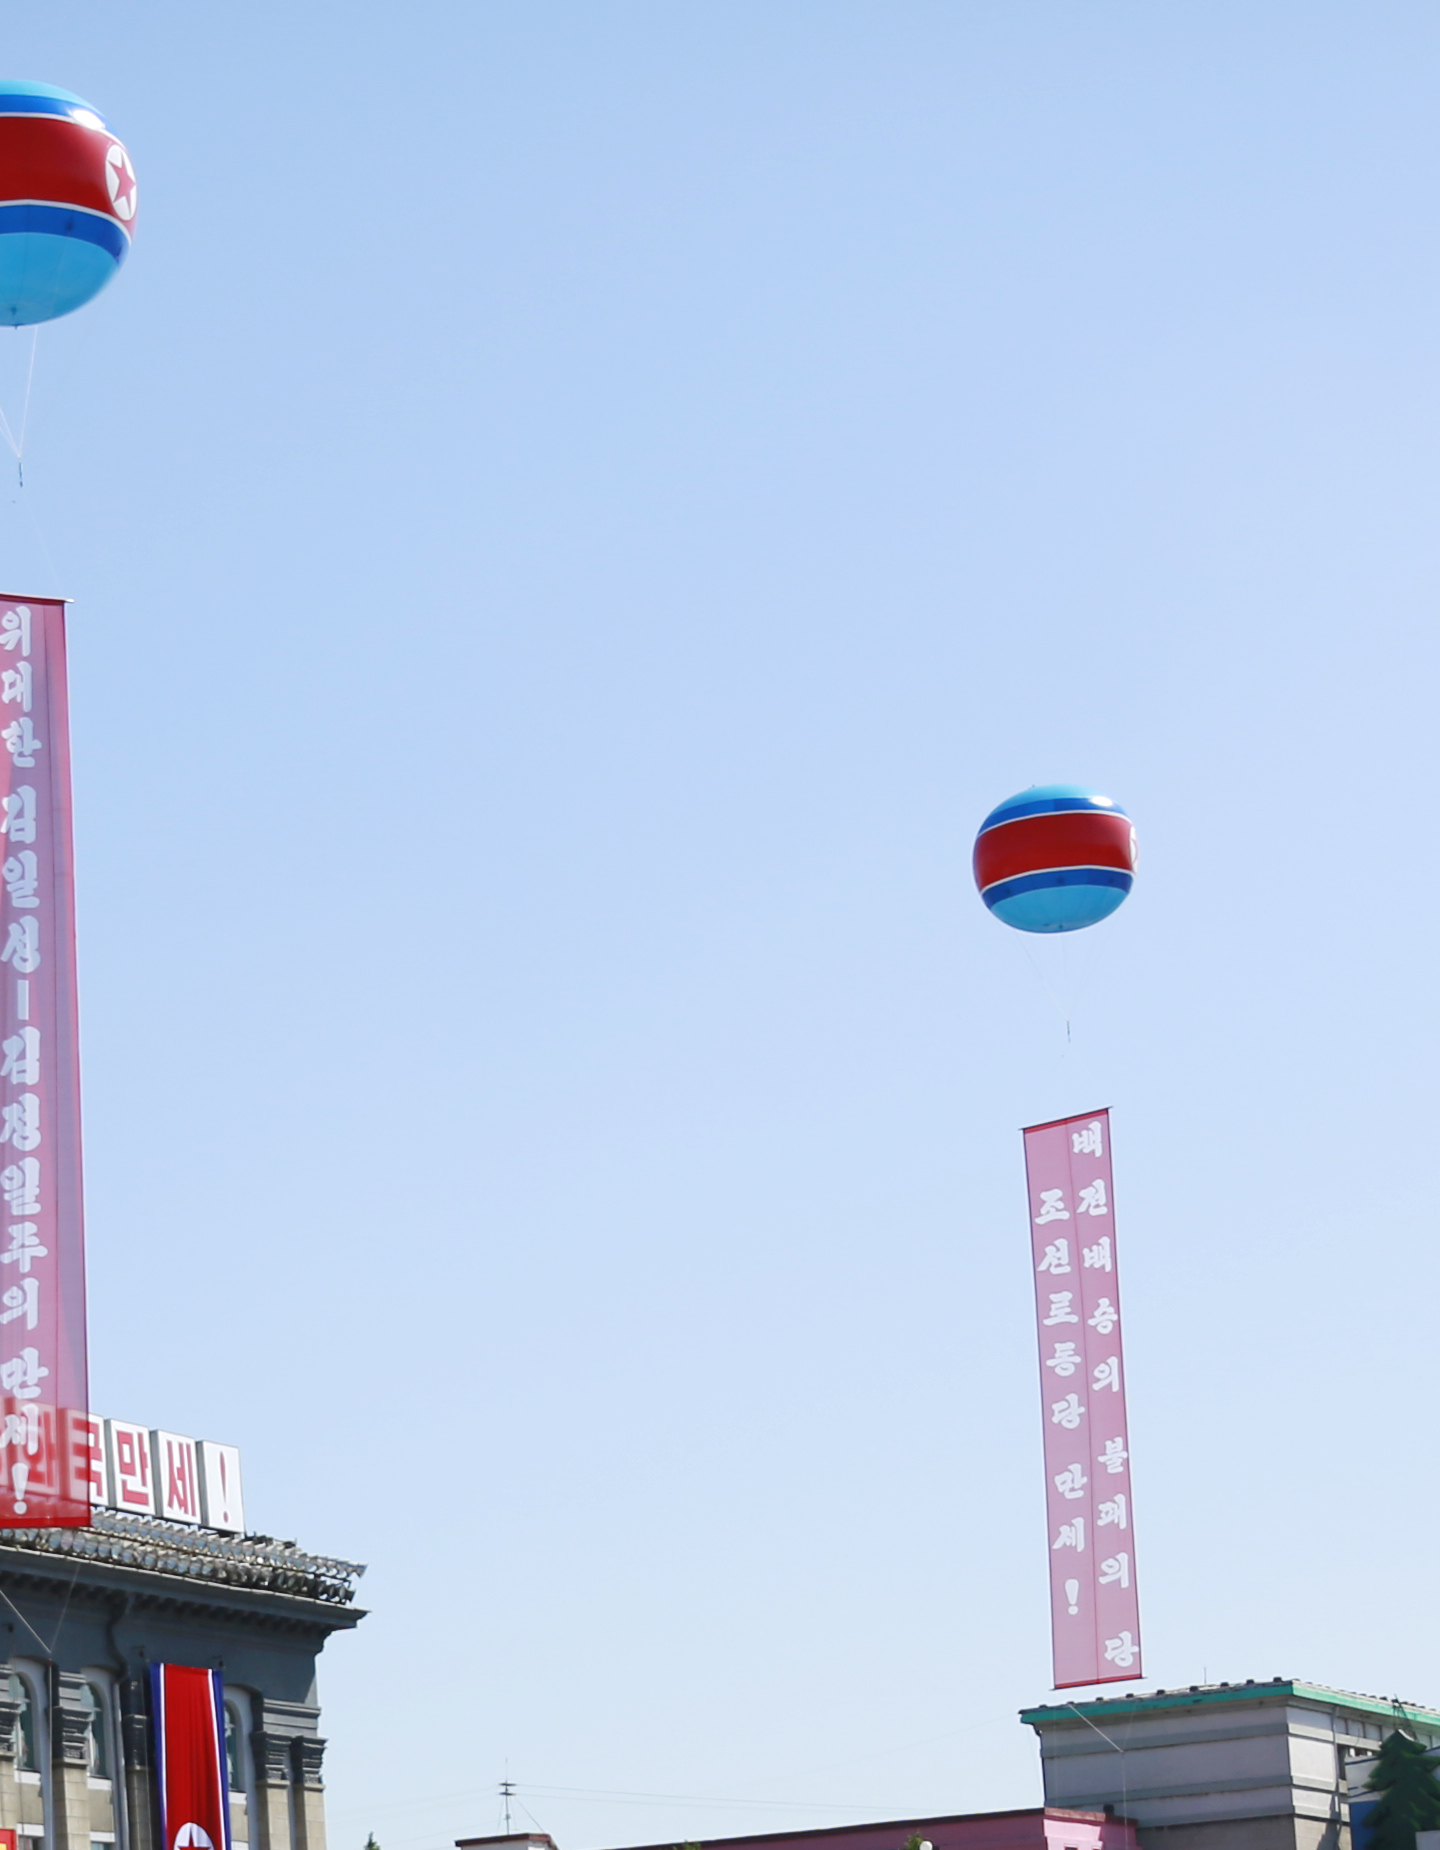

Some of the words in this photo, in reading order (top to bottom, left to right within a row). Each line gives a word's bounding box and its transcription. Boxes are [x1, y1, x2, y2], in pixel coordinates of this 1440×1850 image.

[1034, 1187, 1086, 1430] 조선로동당
[1070, 1120, 1122, 1393] 백전백승의
[1051, 1462, 1088, 1616] 만세!
[1096, 1436, 1129, 1589] 불패의
[1103, 1630, 1140, 1668] 당
